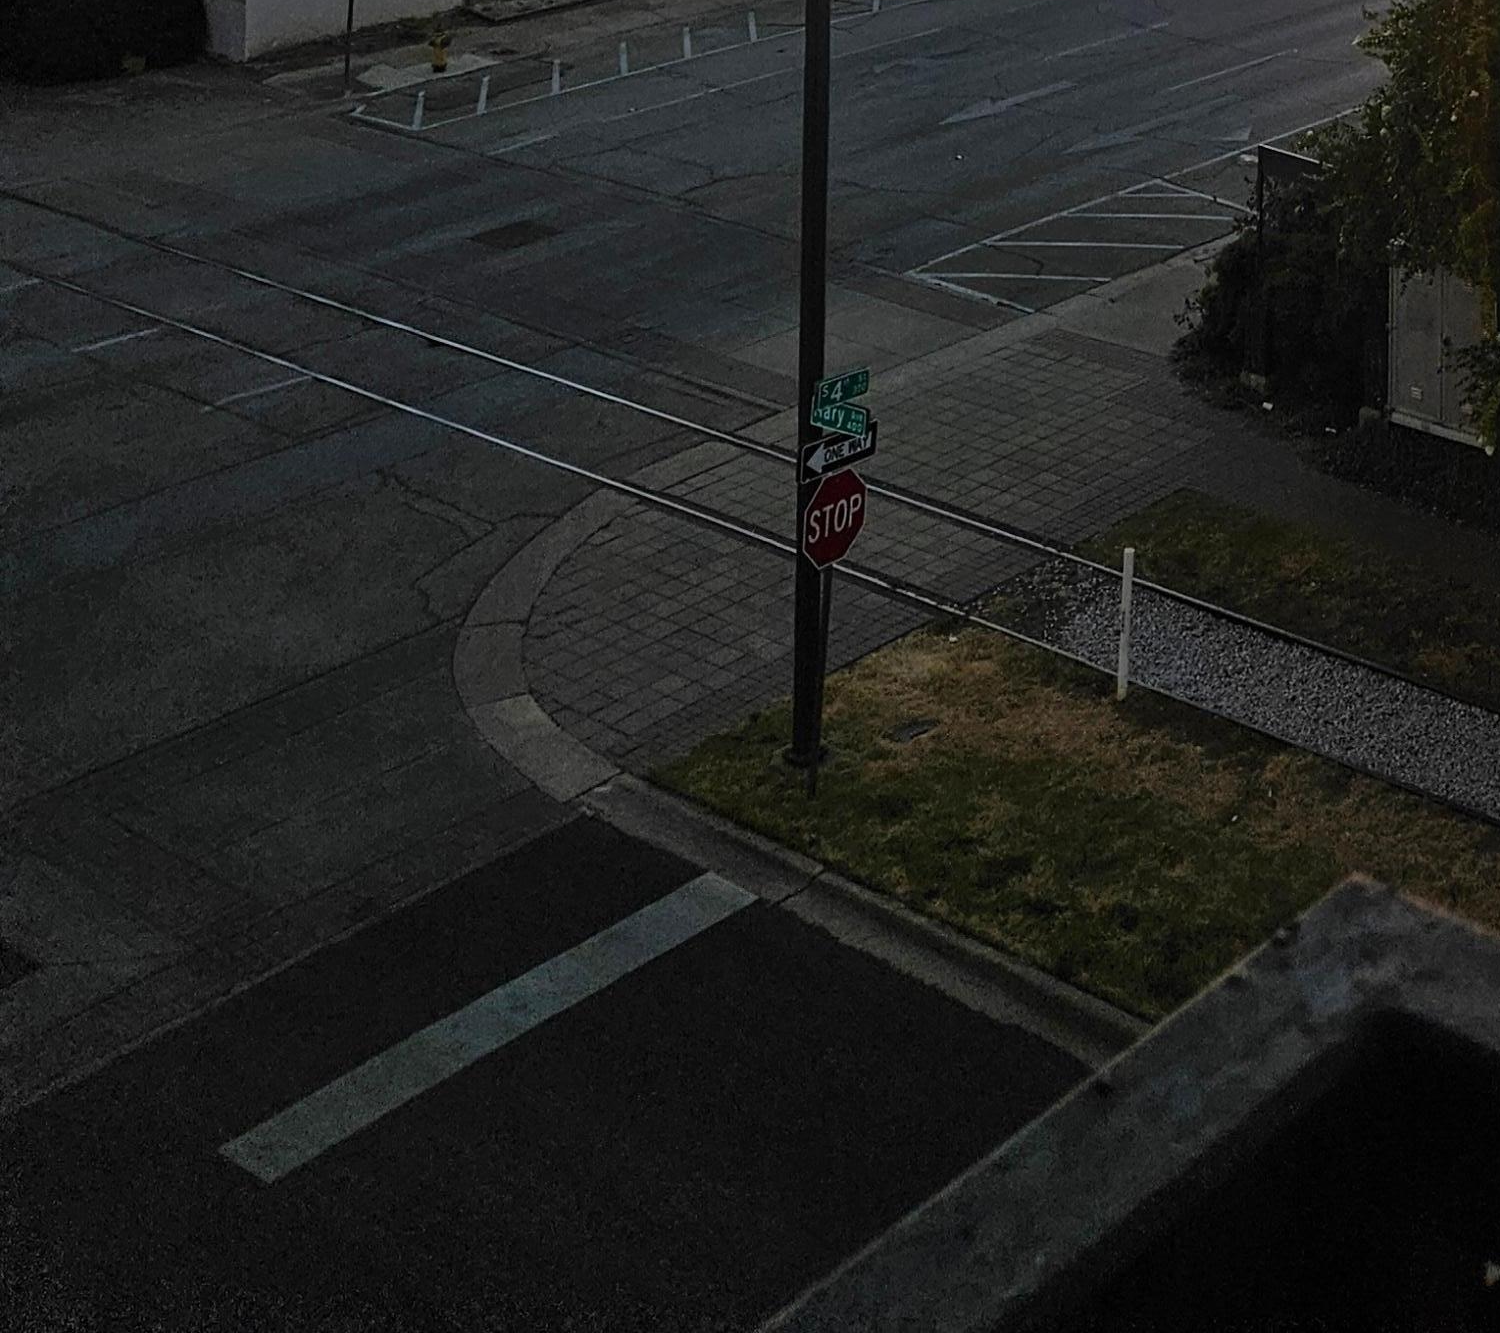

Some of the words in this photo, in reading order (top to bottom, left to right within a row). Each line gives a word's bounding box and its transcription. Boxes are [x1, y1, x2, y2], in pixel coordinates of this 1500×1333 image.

[822, 384, 829, 398] S
[824, 443, 844, 463] ONE
[848, 436, 868, 454] WAY
[808, 493, 862, 543] STOP
